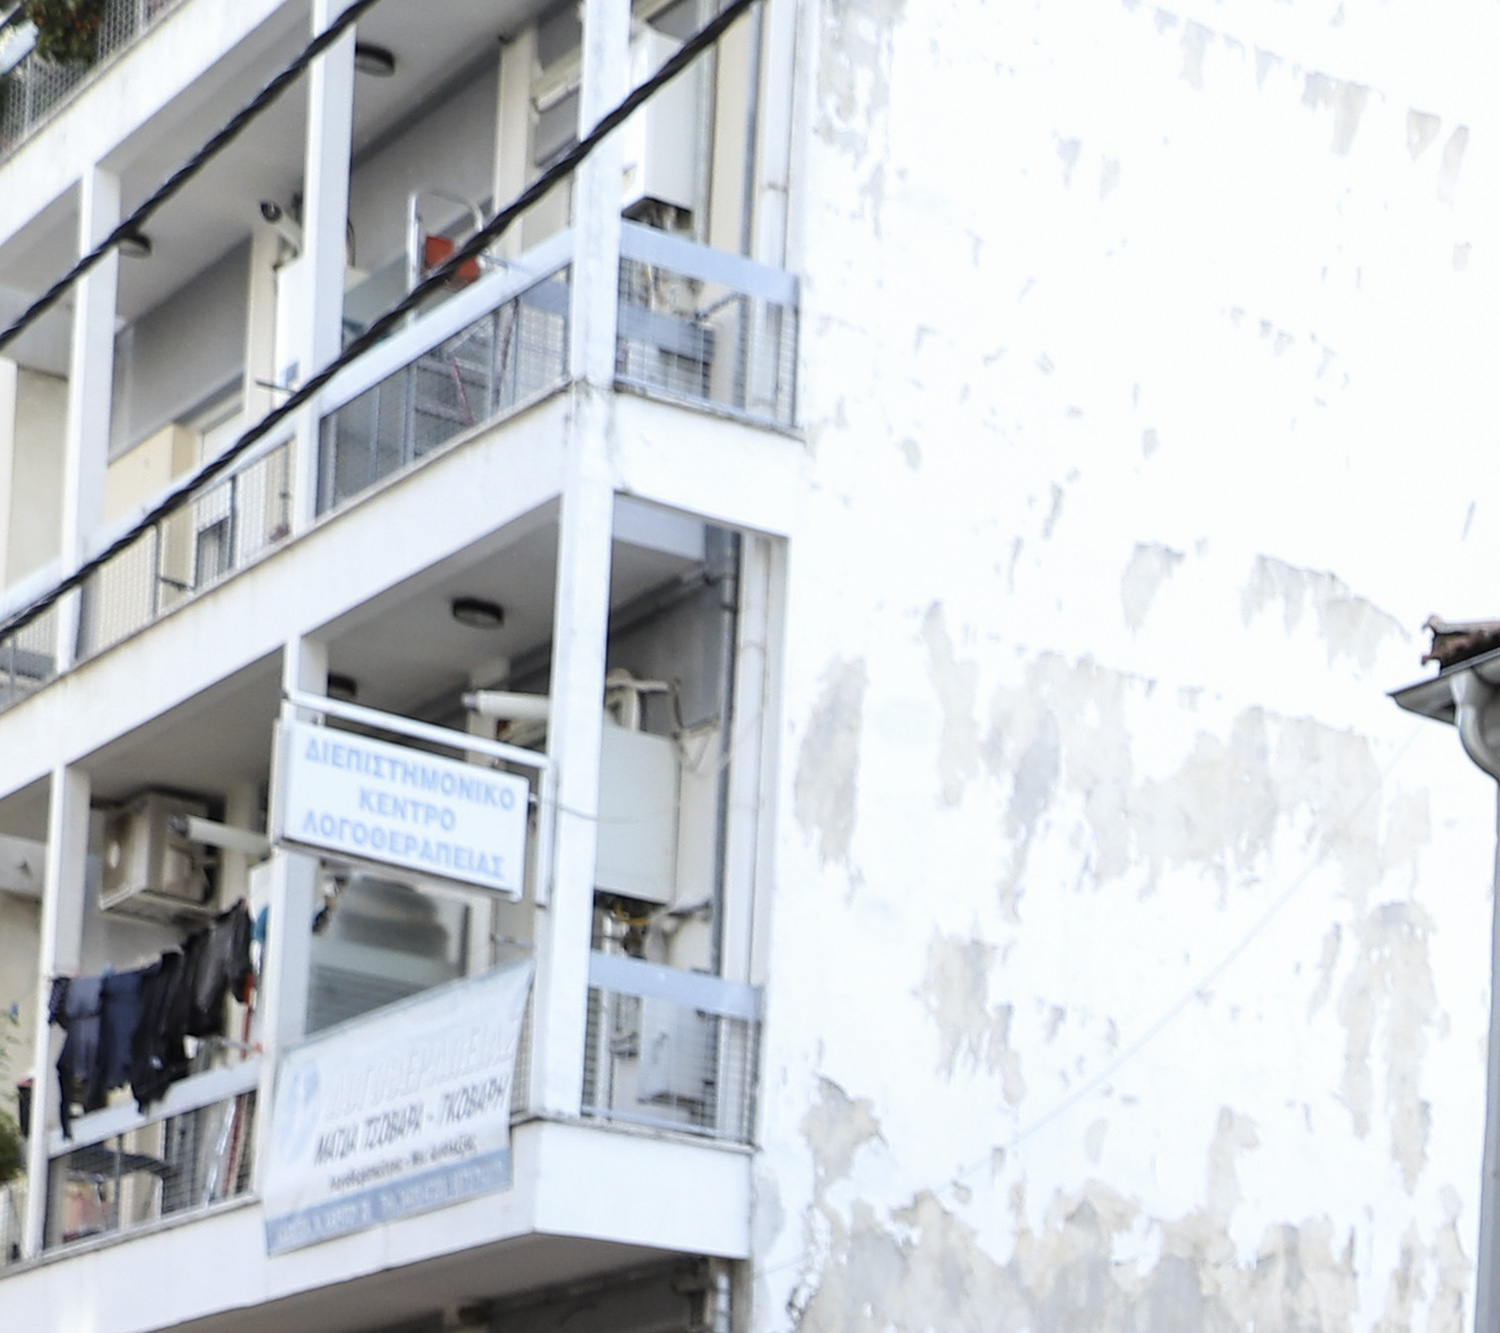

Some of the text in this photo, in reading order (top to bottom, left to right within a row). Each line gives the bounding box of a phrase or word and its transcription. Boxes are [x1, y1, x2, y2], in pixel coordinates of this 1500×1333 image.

[305, 735, 516, 811] ΔΙΕΠΙΣΤΗΜΟΝΙΚΟ
[302, 806, 506, 879] ΛΟΓΟΘΕΡΑΠΕΙΑΣ
[359, 788, 456, 833] ΚΕΝΤΡΟ
